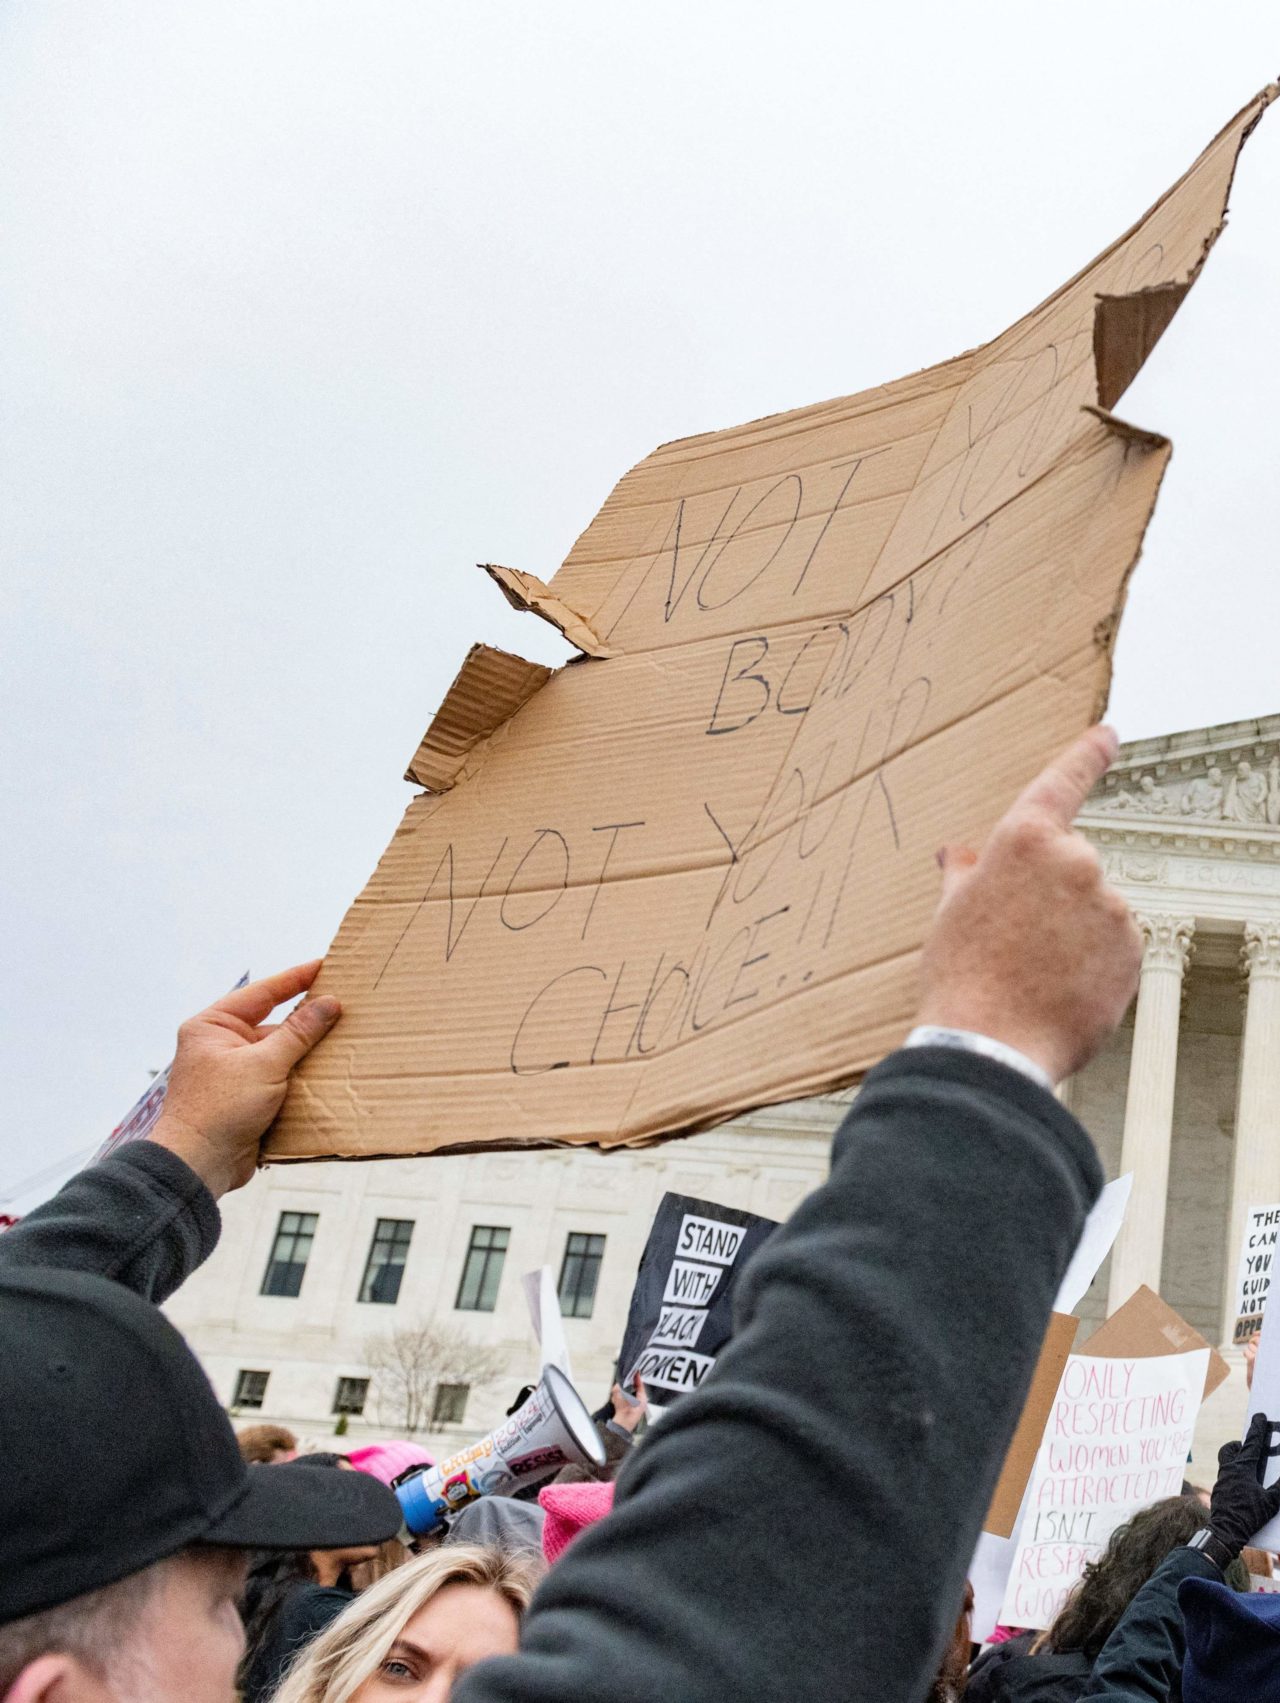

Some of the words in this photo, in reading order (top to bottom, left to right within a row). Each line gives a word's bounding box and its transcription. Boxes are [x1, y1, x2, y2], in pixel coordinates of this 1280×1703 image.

[605, 446, 893, 641] NOT
[373, 821, 646, 990] NOT
[680, 1221, 740, 1260] STAND
[672, 1267, 718, 1302] WITH
[1240, 1296, 1267, 1315] NOT
[1063, 1360, 1136, 1401] ONLY
[1055, 1387, 1187, 1438] RESPECTING
[1049, 1443, 1130, 1474] WOMEN
[1037, 1467, 1159, 1508] ATTRACTED
[1033, 1510, 1097, 1543] ISN'T
